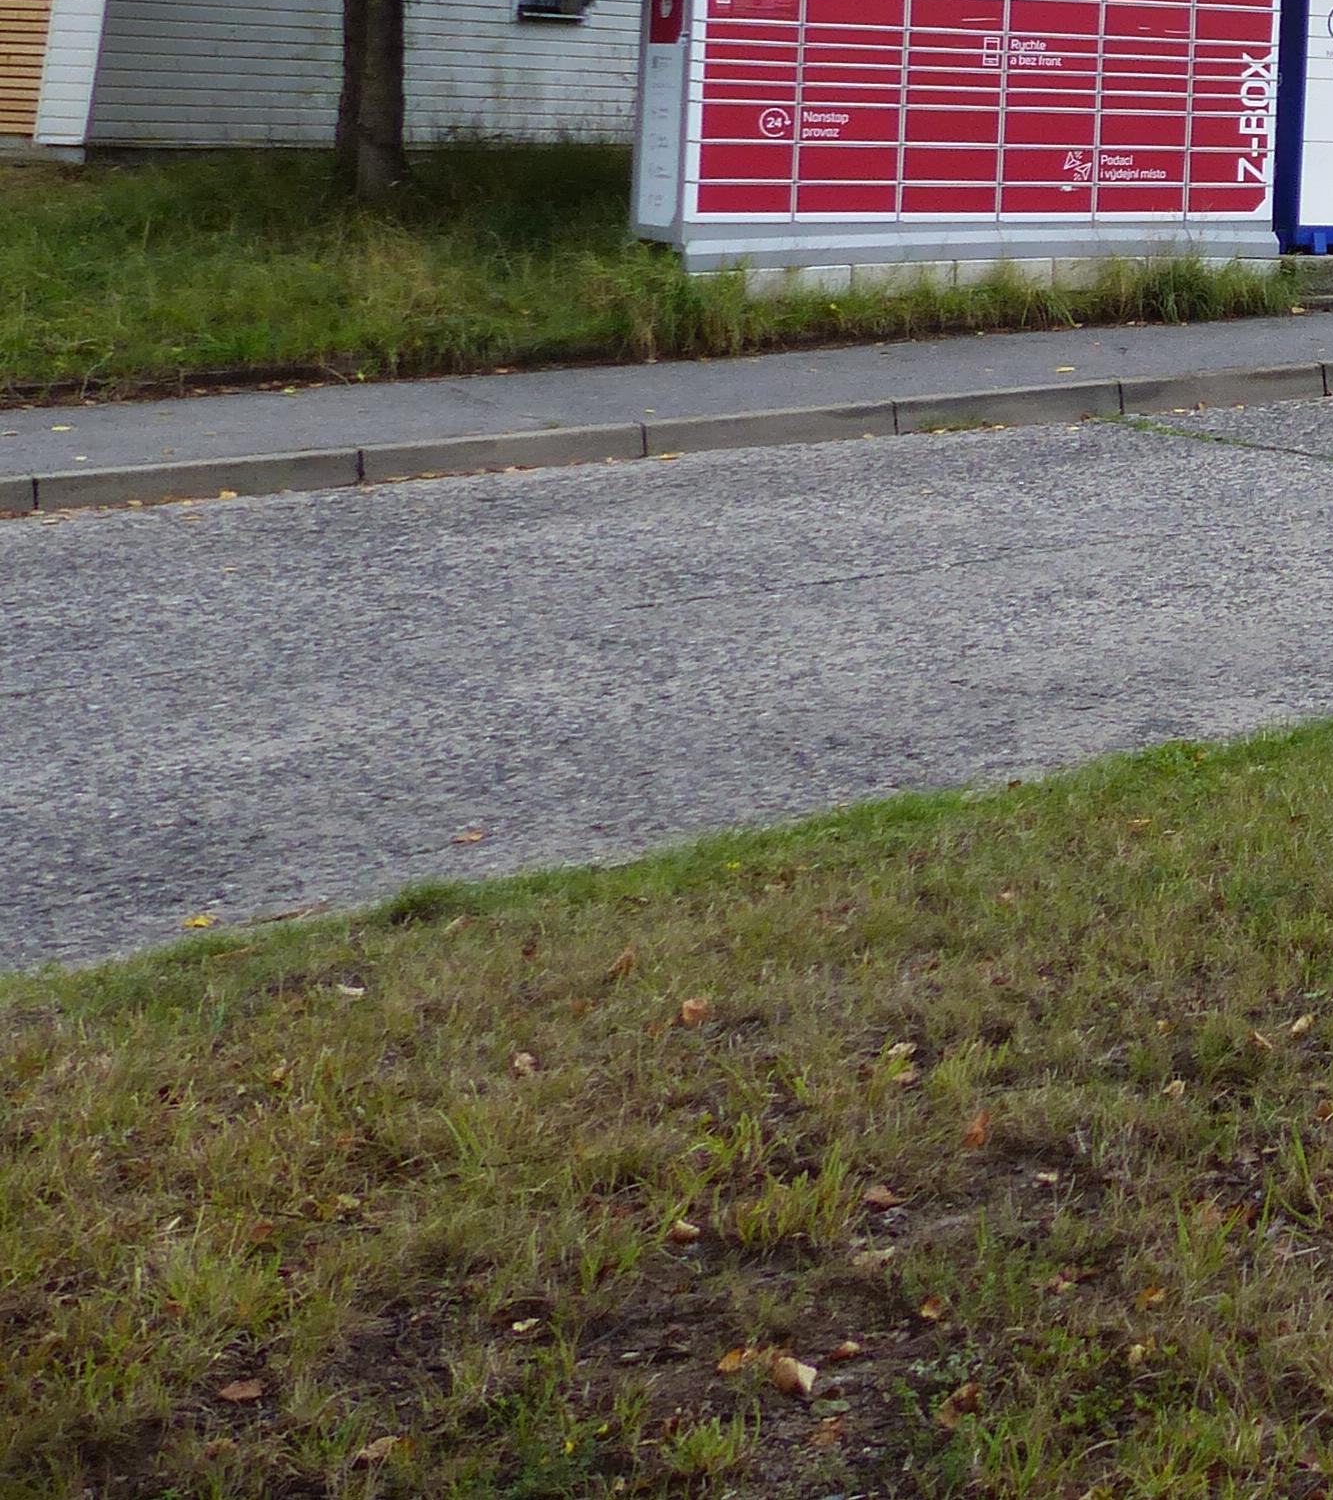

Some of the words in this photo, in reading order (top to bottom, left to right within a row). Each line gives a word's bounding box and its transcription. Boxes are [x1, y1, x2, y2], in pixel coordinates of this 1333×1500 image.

[1011, 39, 1047, 51] Rychle
[1019, 55, 1037, 66] bez
[1038, 56, 1063, 67] front
[766, 117, 782, 128] 24
[803, 111, 849, 125] Nonstop
[1237, 53, 1272, 182] Z-BOX
[802, 128, 840, 139] provoz
